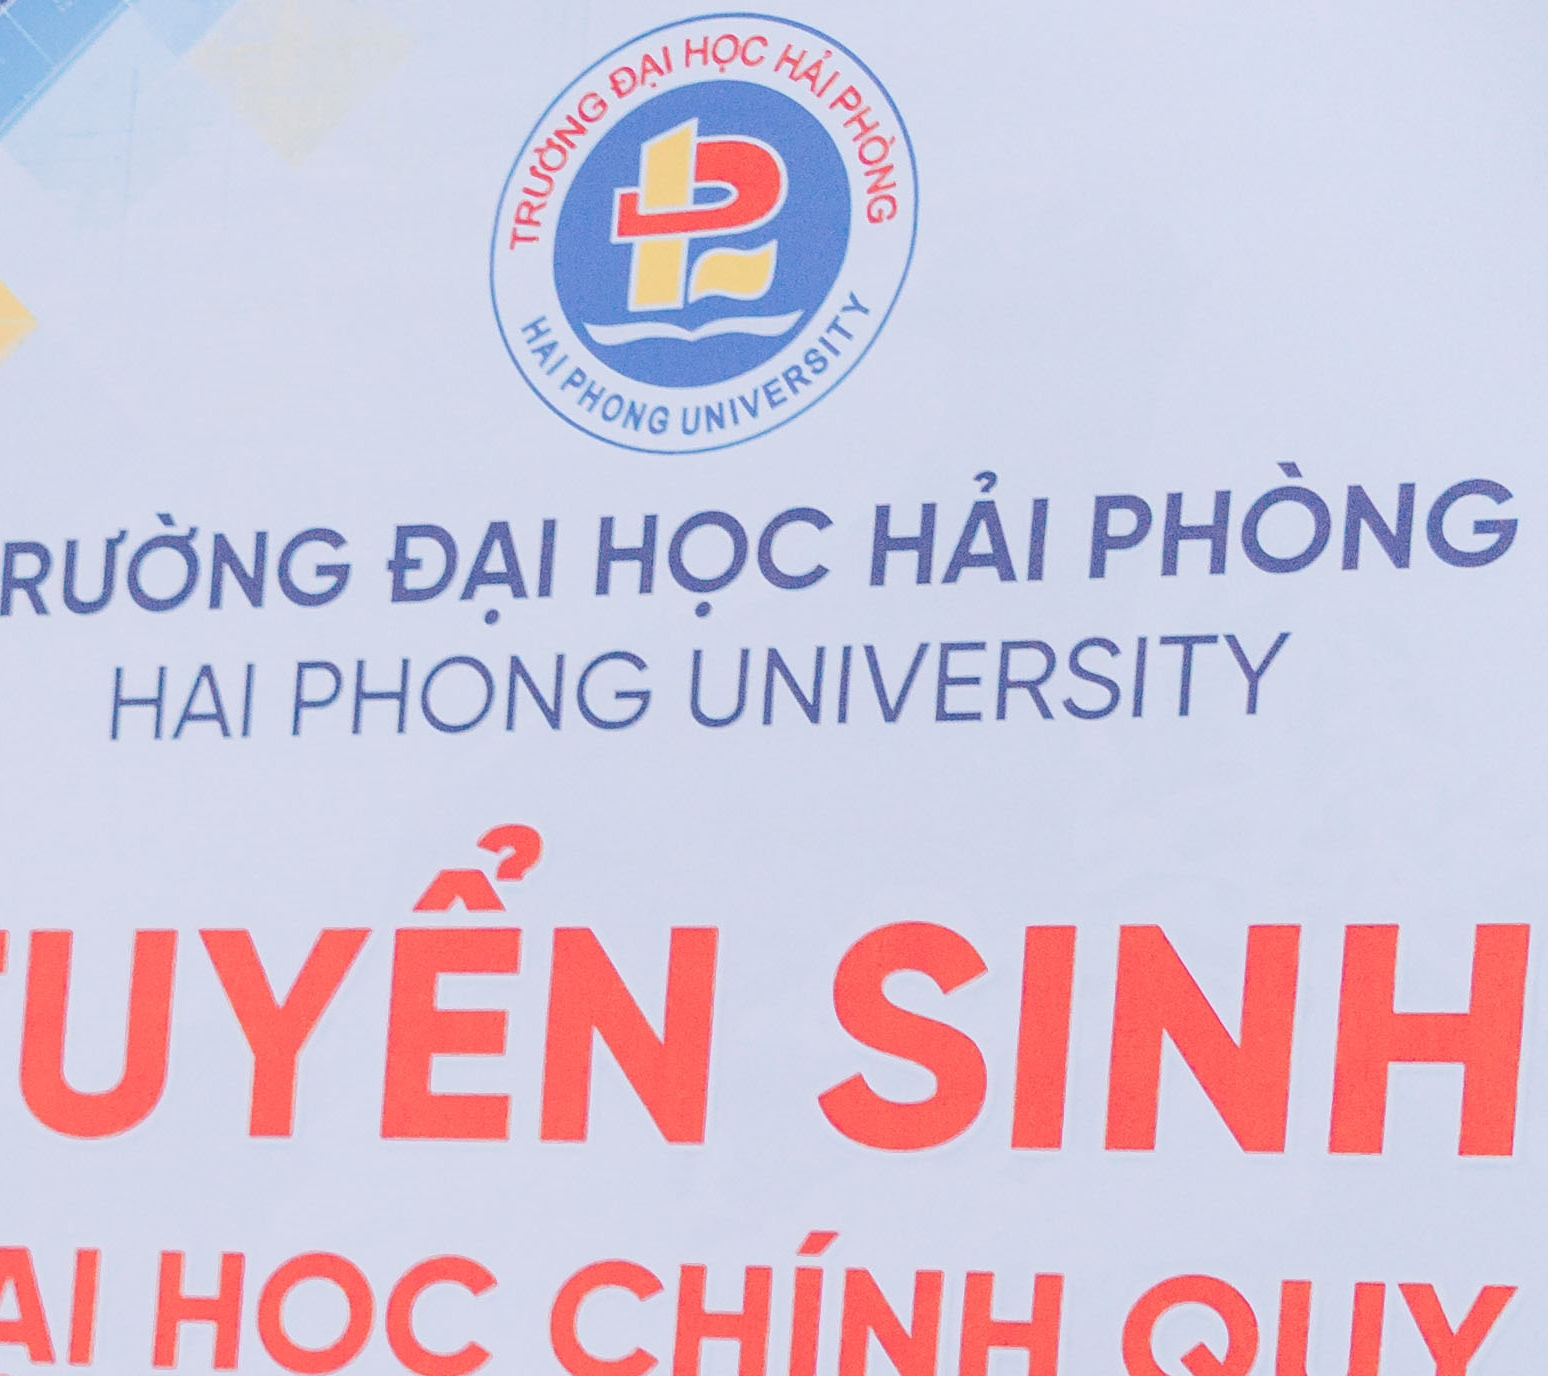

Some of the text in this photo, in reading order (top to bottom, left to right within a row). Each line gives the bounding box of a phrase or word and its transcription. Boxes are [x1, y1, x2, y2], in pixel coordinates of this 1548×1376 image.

[509, 33, 898, 251] TRƯỜNG ĐẠI HỌC HẢI PHÒNG
[520, 290, 870, 436] HAI PHONG UNIVERSITY
[385, 517, 559, 625] ĐẠI
[593, 507, 836, 622] HỌC
[867, 471, 1049, 586] HẢI
[1087, 462, 1520, 577] PHÒNG
[108, 632, 1293, 740] HAI PHONG UNIVERSITY
[815, 919, 1532, 1156] SINH
